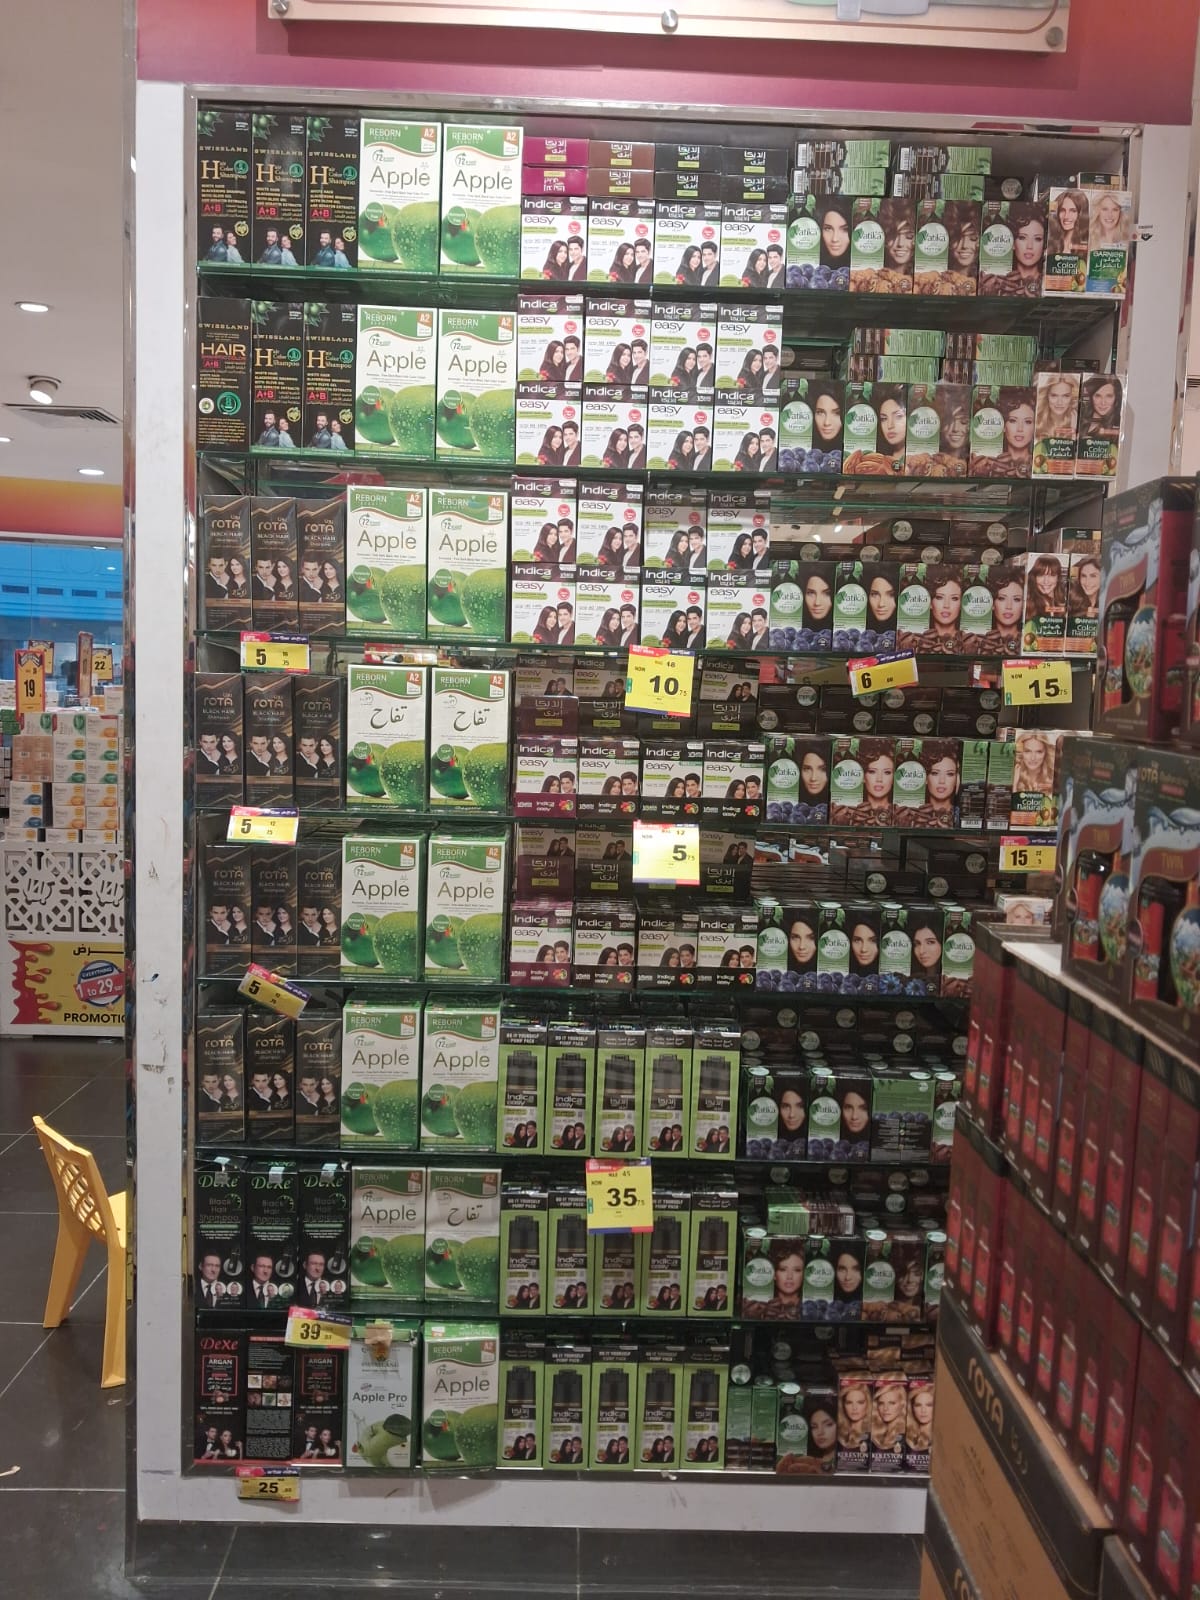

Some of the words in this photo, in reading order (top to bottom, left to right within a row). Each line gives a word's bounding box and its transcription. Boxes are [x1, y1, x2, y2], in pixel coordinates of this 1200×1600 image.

[369, 128, 401, 138] REBORN
[423, 128, 435, 138] A2
[452, 132, 484, 142] REBORN
[505, 132, 517, 142] A2
[370, 165, 431, 189] Apple
[453, 169, 513, 193] Apple
[204, 204, 222, 213] A+B
[524, 199, 563, 209] Indica
[658, 203, 696, 214] Indica
[259, 207, 276, 216] A+B
[312, 209, 330, 217] A+B
[524, 216, 555, 226] easy
[724, 223, 755, 233] easy
[520, 299, 558, 309] Indica
[655, 305, 693, 315] Indica
[720, 307, 758, 318] Indica
[366, 313, 398, 323] REBORN
[419, 313, 431, 323] A2
[448, 317, 479, 327] REBORN
[500, 316, 512, 326] A2
[655, 321, 685, 331] easy
[201, 342, 246, 356] HAIR
[367, 350, 427, 371] Apple
[448, 353, 508, 376] Apple
[586, 387, 623, 397] Indica
[717, 392, 755, 401] Indica
[586, 403, 616, 413] easy
[582, 484, 618, 496] Indica
[356, 494, 387, 504] REBORN
[409, 493, 421, 503] A2
[438, 498, 469, 507] REBORN
[491, 497, 502, 507] A2
[515, 499, 545, 508] easy
[711, 510, 740, 519] easy
[357, 529, 417, 551] Apple
[439, 534, 498, 555] Apple
[579, 568, 616, 579] Indica
[711, 573, 747, 583] Indica
[646, 586, 676, 596] easy
[256, 649, 267, 666] 5
[95, 661, 105, 670] 22
[356, 672, 387, 682] REBORN
[409, 672, 420, 682] A2
[440, 676, 471, 686] REBORN
[492, 675, 503, 685] A2
[861, 672, 872, 689] 6
[24, 679, 36, 698] 19
[650, 675, 679, 696] 10
[1029, 678, 1060, 698] 15
[370, 705, 408, 729] تفاح
[454, 708, 491, 732] تفاح
[519, 745, 554, 754] Indica
[646, 749, 681, 758] Indica
[582, 761, 611, 770] easy
[241, 819, 252, 834] 5
[351, 847, 382, 855] REBORN
[436, 849, 467, 858] REBORN
[672, 845, 687, 862] 5
[1011, 850, 1028, 867] 15
[352, 879, 410, 901] Apple
[437, 881, 495, 903] Apple
[514, 916, 548, 924] Indica
[641, 920, 675, 928] Indica
[701, 921, 735, 930] Indica
[514, 929, 543, 938] easy
[700, 935, 729, 943] easy
[82, 967, 113, 978] EVERYTHING
[76, 984, 83, 998] 1
[87, 988, 97, 997] to
[97, 979, 114, 994] 29
[249, 980, 262, 995] 5
[351, 1016, 382, 1025] REBORN
[432, 1018, 462, 1027] REBORN
[352, 1049, 410, 1072] Apple
[433, 1051, 490, 1072] Apple
[607, 1188, 638, 1207] 35
[362, 1205, 417, 1225] Apple
[448, 1204, 483, 1225] تفاح
[300, 1323, 321, 1340] 39
[433, 1346, 463, 1354] REBORN
[434, 1376, 491, 1397] Apple
[353, 1392, 385, 1403] Apple
[388, 1392, 408, 1403] Pro
[259, 1482, 279, 1494] 25
